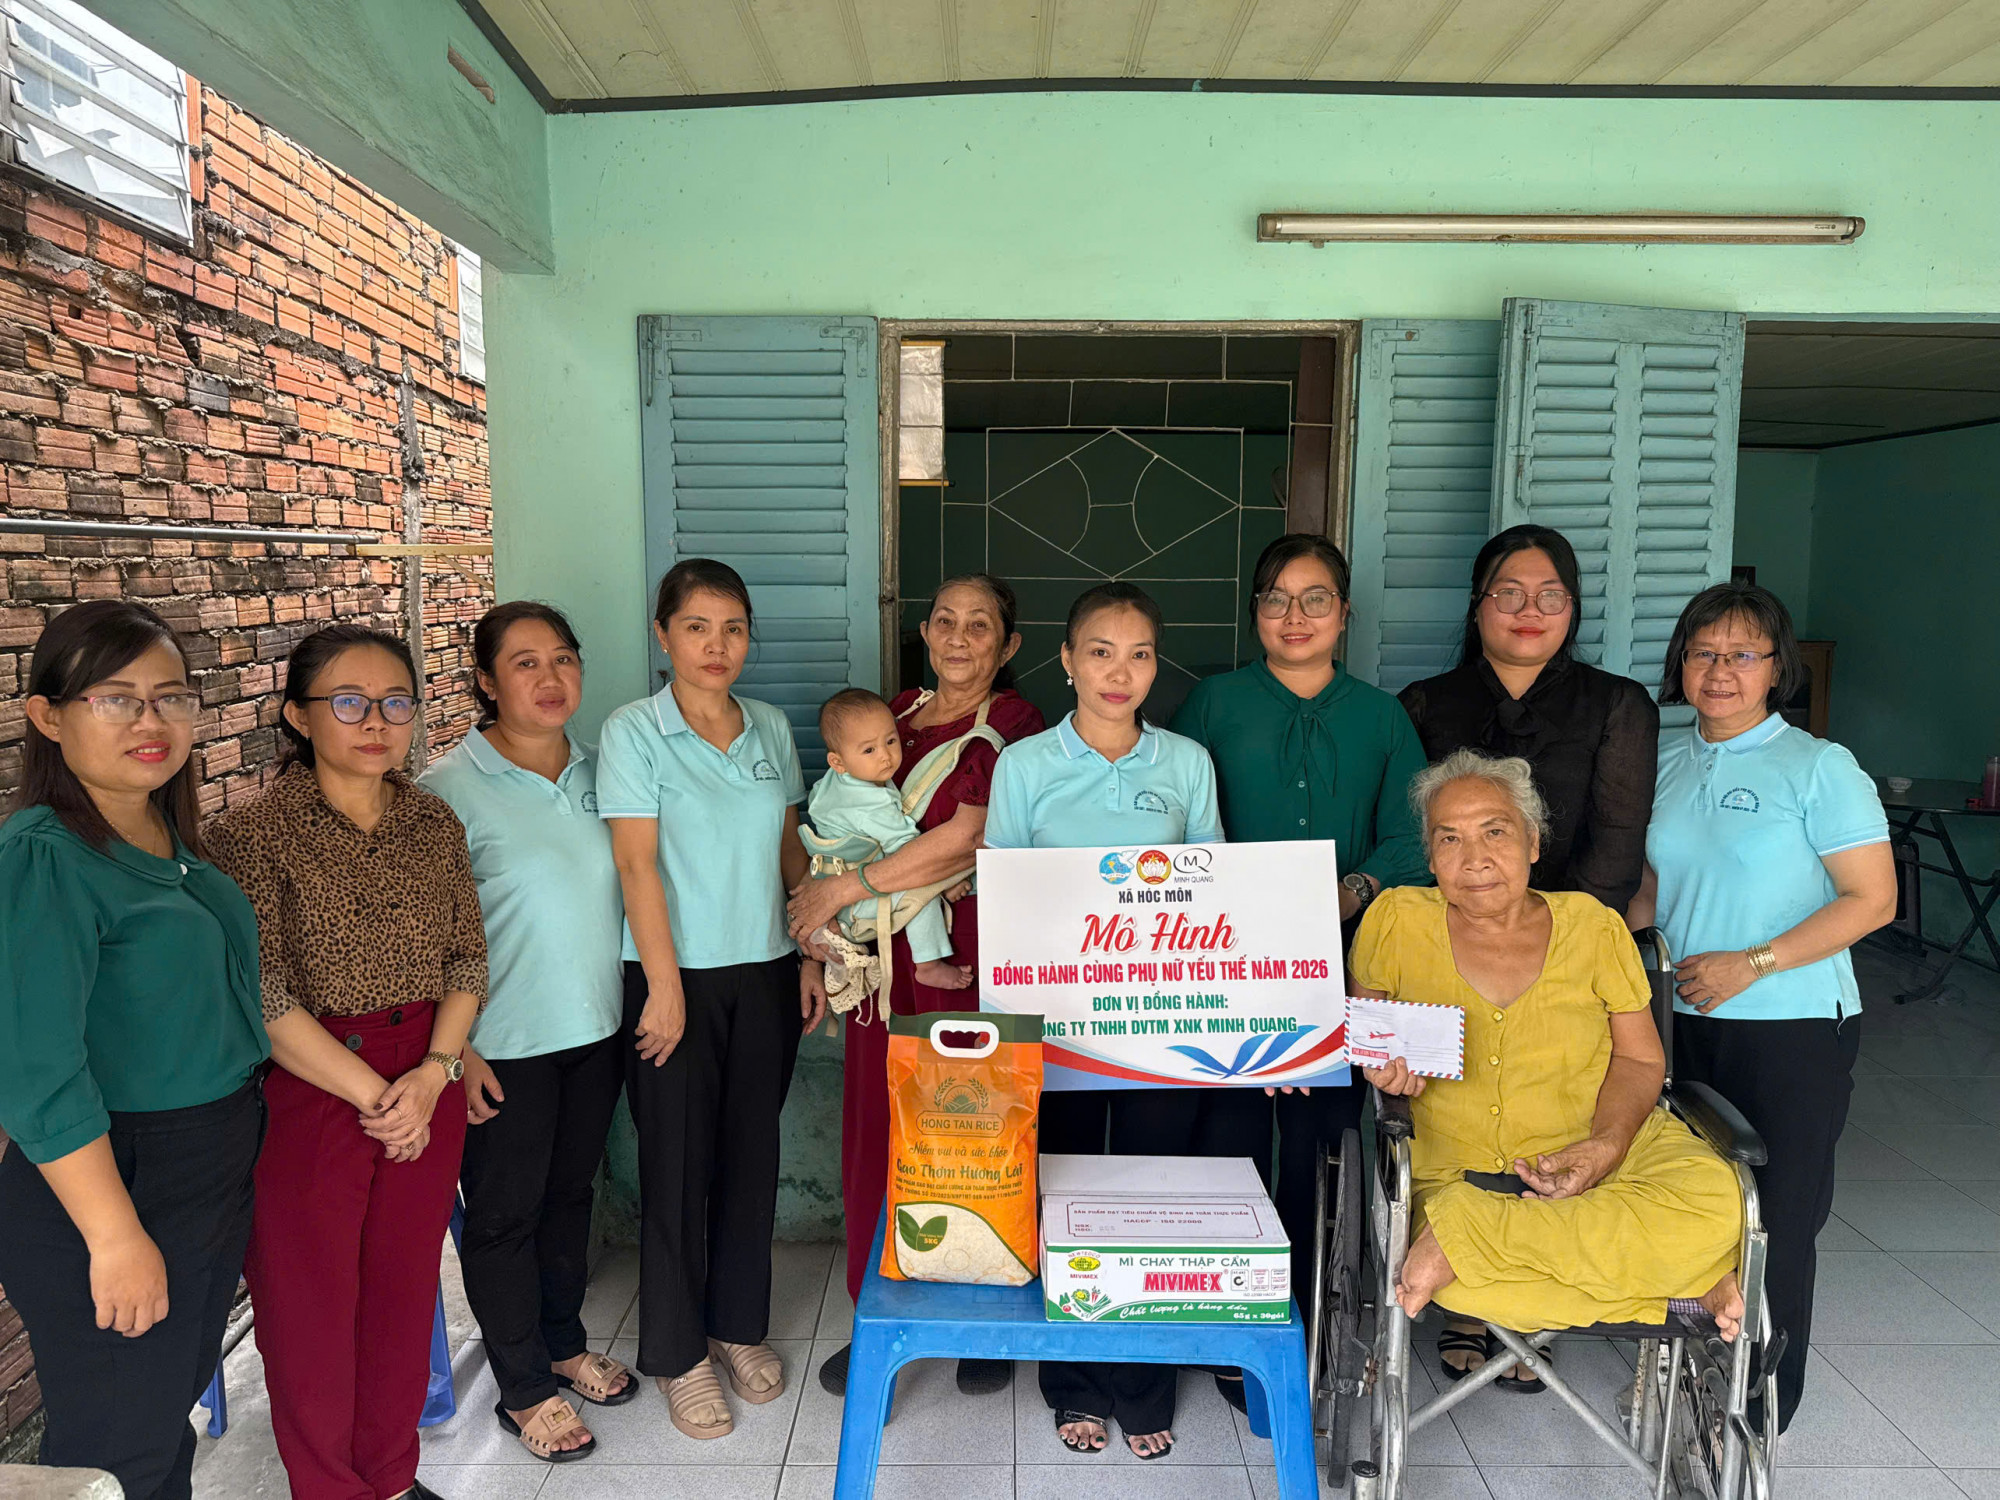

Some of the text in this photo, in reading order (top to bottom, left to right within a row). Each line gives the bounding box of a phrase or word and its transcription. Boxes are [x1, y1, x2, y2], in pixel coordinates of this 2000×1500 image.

[1119, 887, 1192, 903] XÃ HÓC MÔN
[1080, 912, 1235, 953] Mô Hình
[993, 954, 1328, 986] ĐỒNG HÀNH CÙNG PHỤ NỮ YẾU THẾ NĂM 2026
[1093, 991, 1229, 1014] ĐƠN VỊ ĐỒNG HÀNH:
[1042, 1017, 1298, 1036] NG TY TNHH DVTM XNK MINH QUANG
[921, 1119, 999, 1131] HONG TAN RICE
[909, 1141, 935, 1156] Niềm
[938, 1146, 952, 1156] vui
[954, 1147, 967, 1156] và
[971, 1147, 986, 1157] sức
[896, 1158, 1023, 1183] Gạo Thơm Hương Lài
[1119, 1255, 1250, 1270] MÌ CHAY THẬP CẨM
[1144, 1272, 1222, 1292] MIVIMEX
[1120, 1305, 1146, 1319] Chất
[1150, 1304, 1179, 1314] lượng
[1182, 1303, 1194, 1311] là
[1233, 1312, 1250, 1320] 65g
